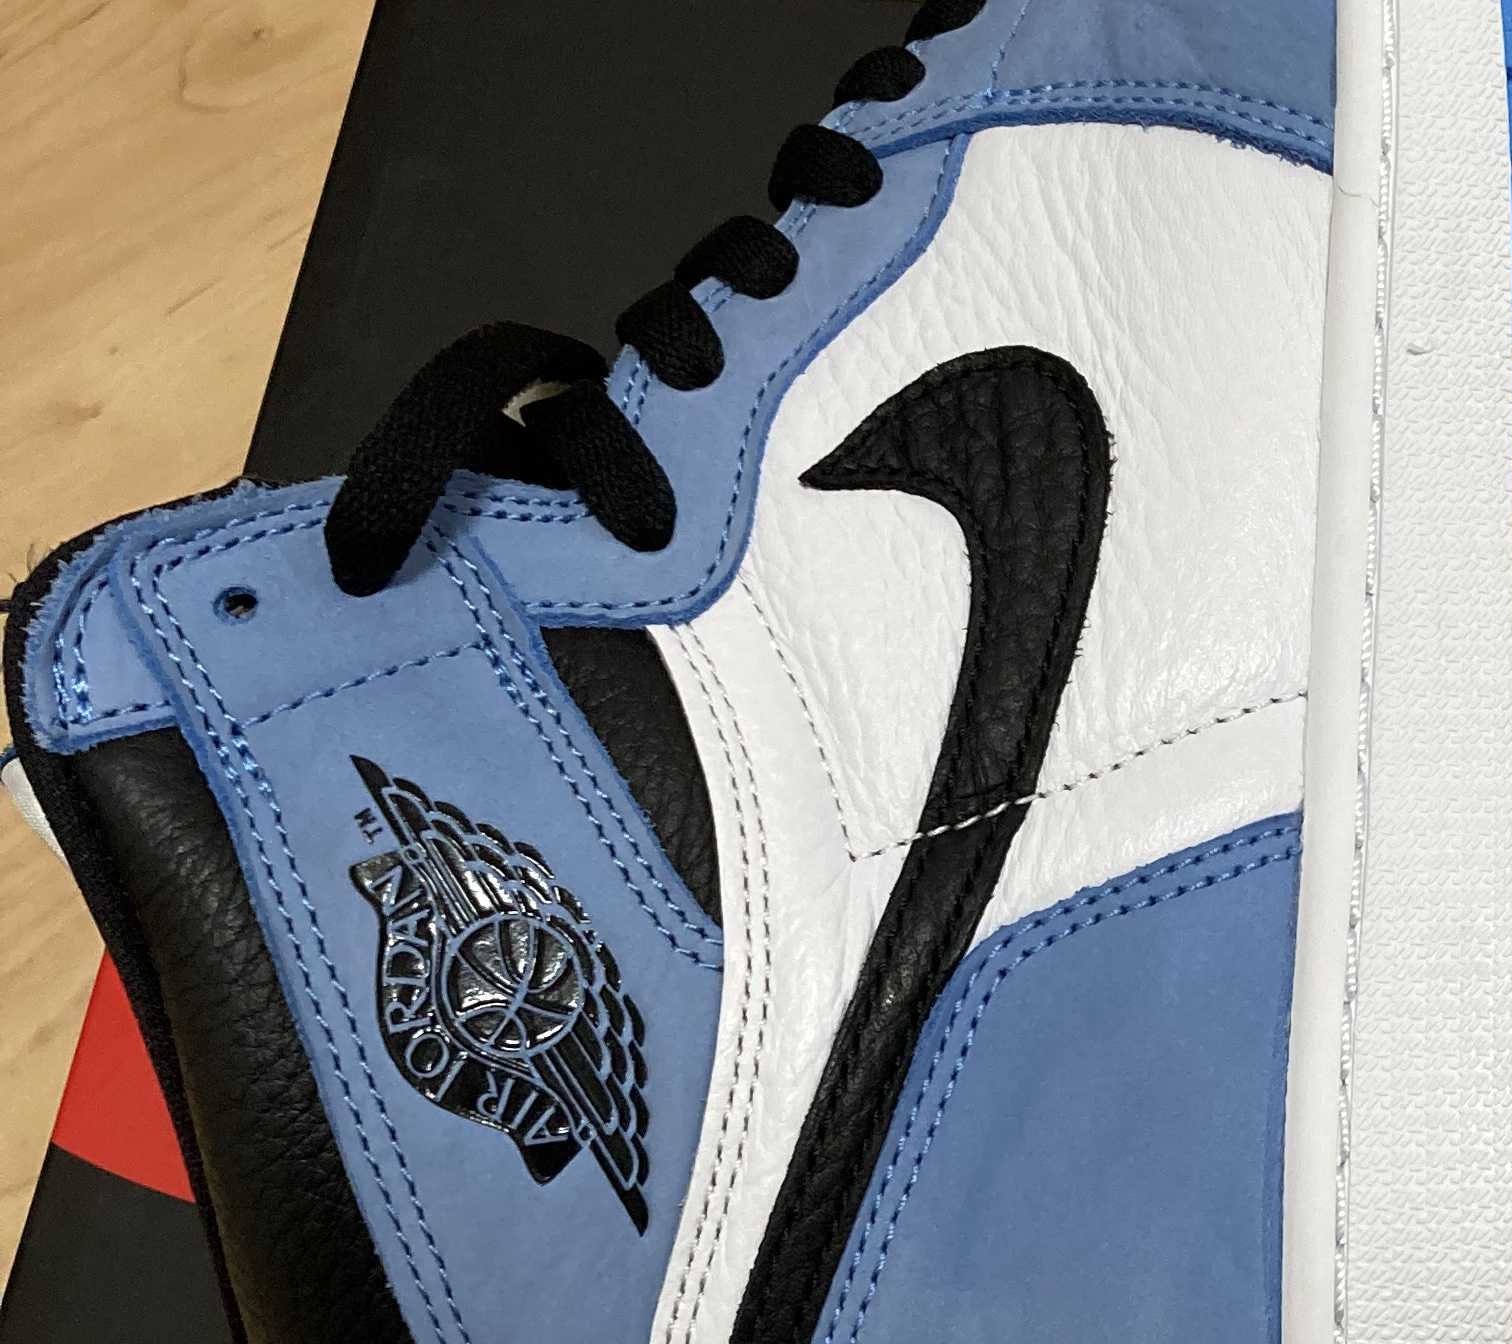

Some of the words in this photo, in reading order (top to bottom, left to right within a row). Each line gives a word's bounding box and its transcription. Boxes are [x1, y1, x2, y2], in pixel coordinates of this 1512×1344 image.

[353, 806, 384, 845] TM
[372, 866, 468, 1102] JORDAN
[477, 1068, 570, 1147] AIR
